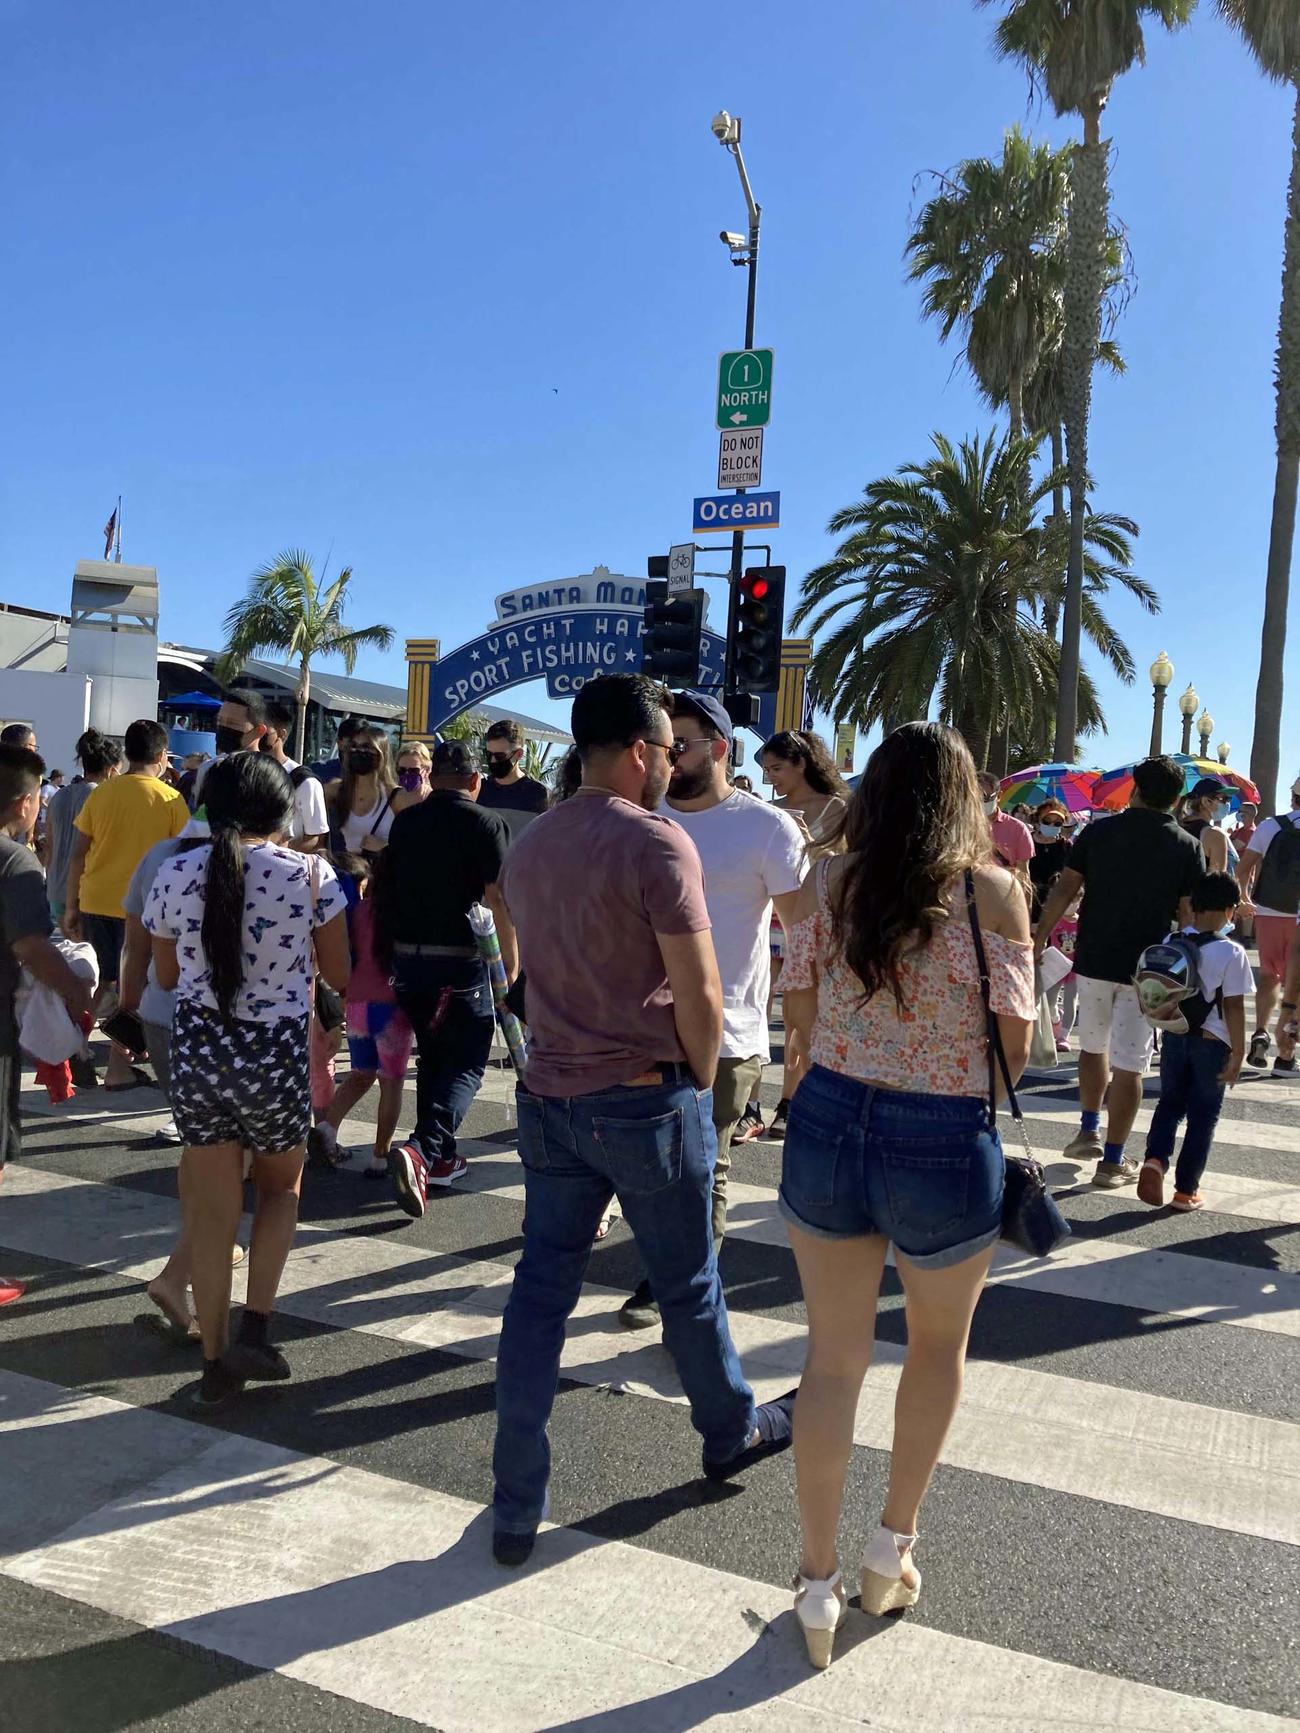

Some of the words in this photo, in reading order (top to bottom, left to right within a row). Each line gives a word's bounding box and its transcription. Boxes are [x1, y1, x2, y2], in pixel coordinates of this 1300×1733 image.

[743, 364, 749, 382] 1
[721, 390, 768, 407] NORTH
[723, 438, 737, 452] DO
[740, 436, 760, 450] NOT
[722, 455, 759, 470] BLOCK
[720, 472, 759, 484] INTERSECTION
[700, 500, 773, 521] Ocean
[670, 574, 690, 585] SIGNAL
[500, 586, 581, 618] SANTA
[487, 618, 574, 655] YACHT
[444, 656, 510, 709] SPORT
[521, 641, 616, 673] FISHING
